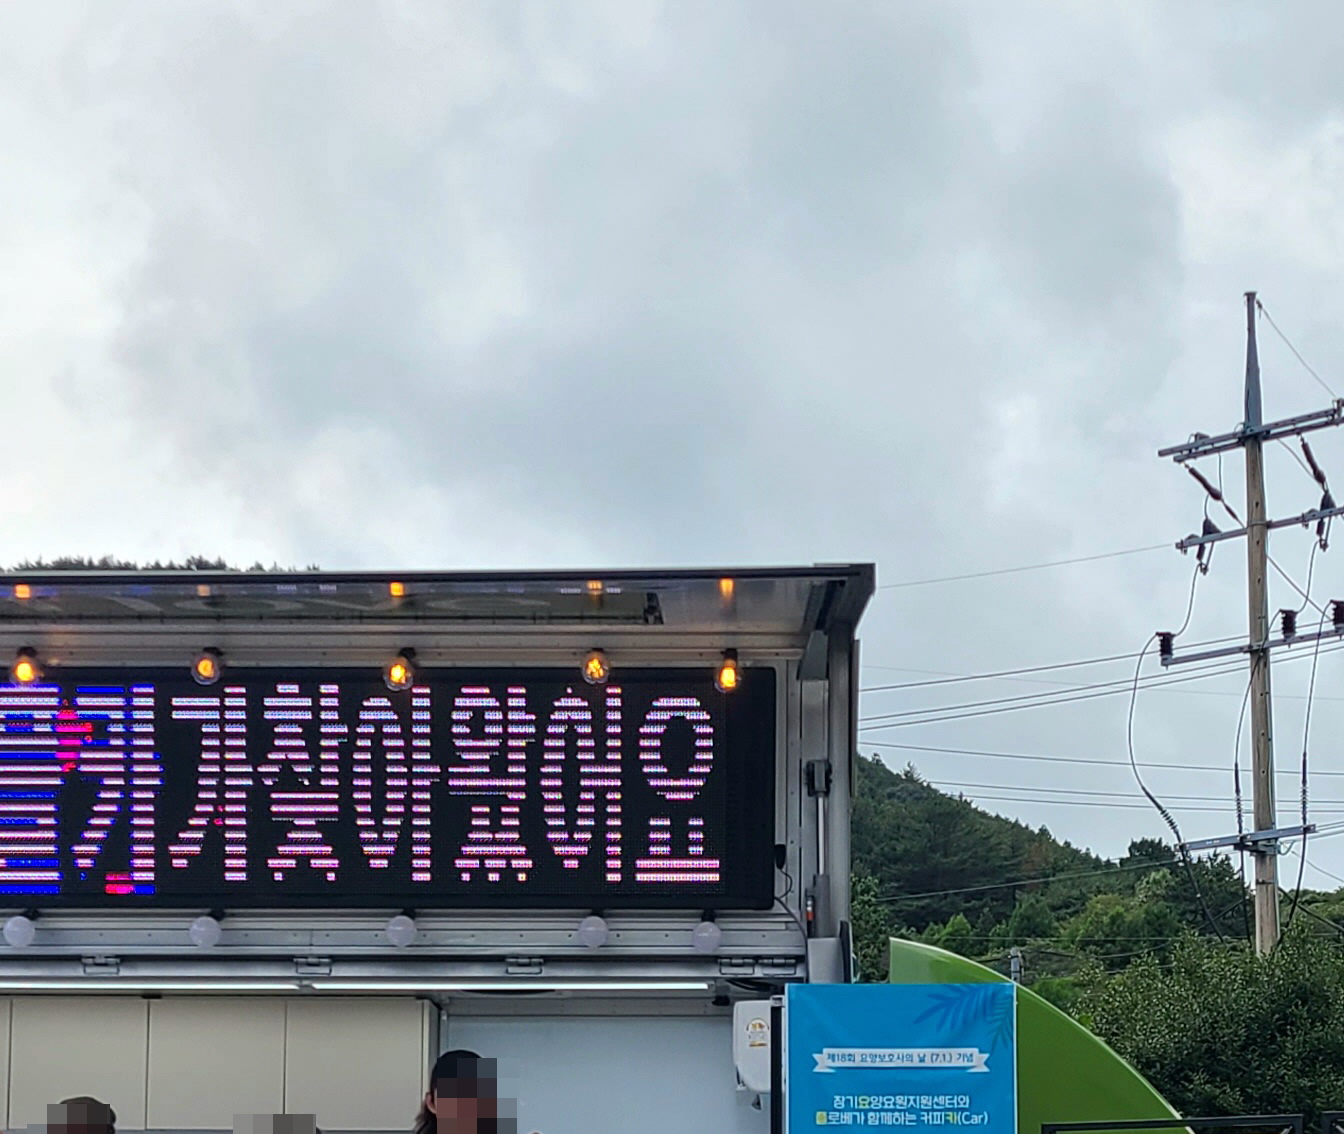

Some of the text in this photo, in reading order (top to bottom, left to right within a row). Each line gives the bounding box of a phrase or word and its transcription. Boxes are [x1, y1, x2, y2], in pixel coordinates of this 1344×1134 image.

[826, 1052, 856, 1064] 제18회
[859, 1052, 914, 1064] 요양보호사의
[917, 1052, 927, 1064] 날
[956, 1052, 975, 1064] 기념
[832, 1095, 971, 1110] 장기요양요원지원센터와
[867, 1111, 918, 1126] 함께하는
[920, 1111, 989, 1126] 커피카(Car)
